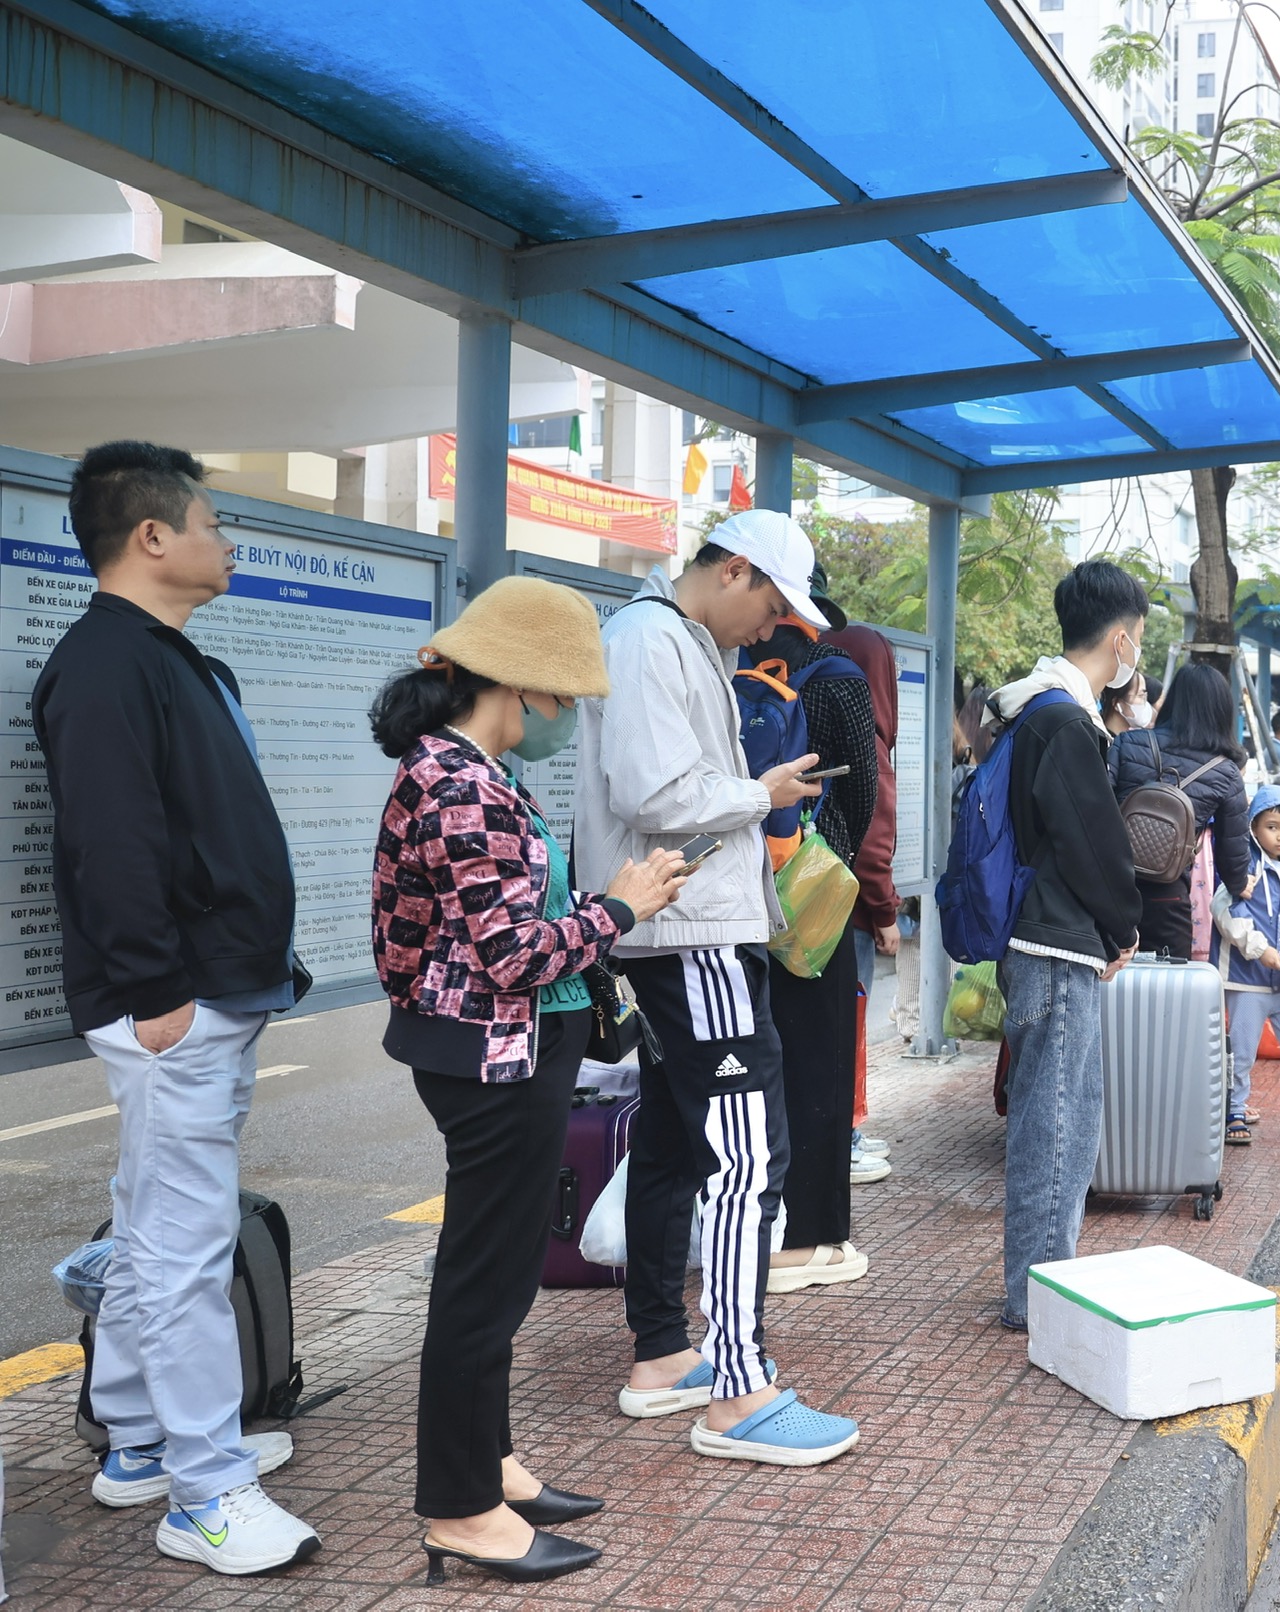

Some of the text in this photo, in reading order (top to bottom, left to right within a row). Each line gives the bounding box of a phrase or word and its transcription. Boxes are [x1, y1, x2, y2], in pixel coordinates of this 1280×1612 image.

[37, 550, 56, 564] ĐẦU
[249, 545, 375, 585] BUÝT NỘI ĐÔ, KẾ CẬN
[27, 576, 93, 592] BẾN XE GIÁP BÁT
[280, 585, 308, 599] LỘ TRÌNH
[29, 593, 89, 609] BẾN XE GIA LÂM
[27, 616, 55, 628] BẾN XE
[210, 614, 229, 623] Dương
[245, 606, 259, 616] Hưng
[261, 608, 271, 616] Đạo
[328, 617, 343, 626] Quang
[17, 635, 56, 648] PHÚC LỢI
[244, 637, 259, 647] Hưng
[260, 639, 271, 647] Đạo
[328, 646, 343, 655] Quang
[26, 658, 42, 669] BẾN
[9, 716, 33, 728] HỒNG
[25, 782, 41, 793] BẾN
[12, 799, 47, 810] TÂN DÂN
[25, 822, 53, 835] BẾN XE
[13, 842, 48, 853] PHÚ TÚC
[25, 864, 53, 875] BẾN XE
[21, 881, 49, 894] BẾN XE
[11, 906, 51, 919] KĐT PHÁP
[21, 923, 49, 935] BẾN XE
[24, 946, 53, 959] BẾN XE
[26, 966, 42, 976] KĐT
[6, 986, 55, 1002] BẾN XE NAM
[24, 1007, 53, 1020] BẾN XE
[715, 1066, 748, 1077] adidas
